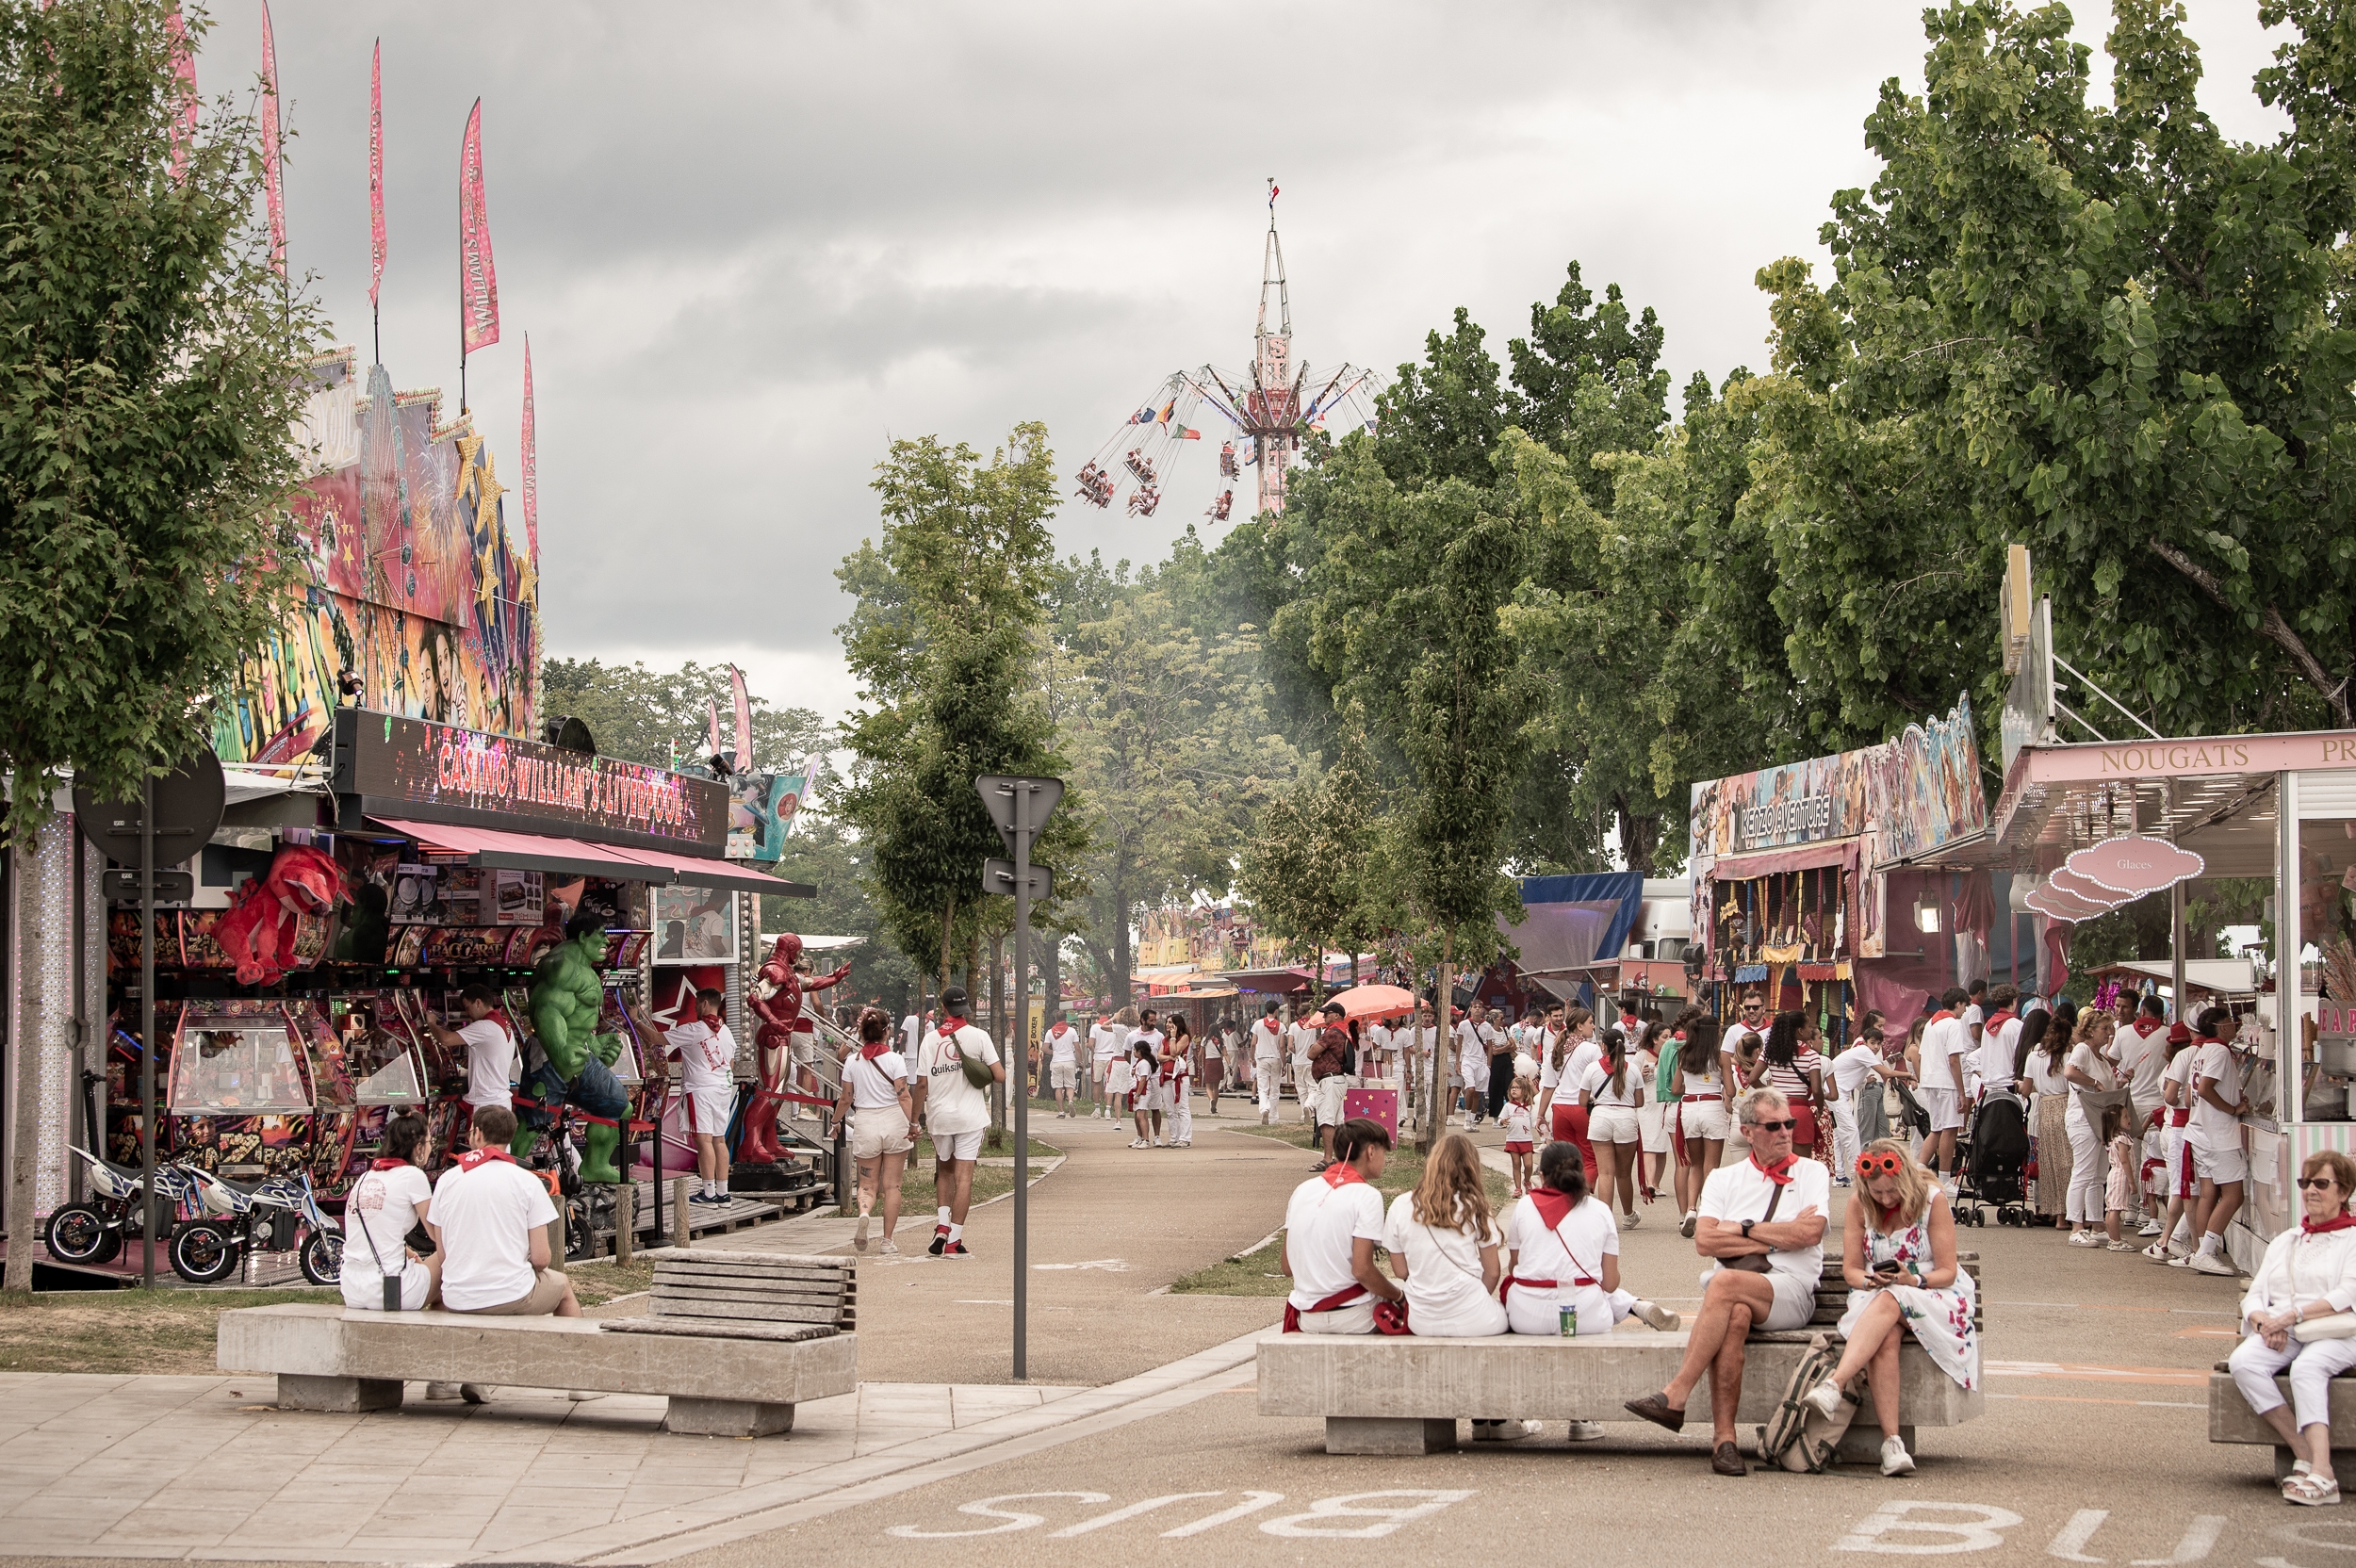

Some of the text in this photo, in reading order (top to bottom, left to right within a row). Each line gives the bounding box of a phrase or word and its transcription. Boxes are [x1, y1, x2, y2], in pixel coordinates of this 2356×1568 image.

[466, 238, 498, 334] WILLIAM'S
[2101, 739, 2356, 773] NOUGATS PR
[438, 743, 683, 826] CASINO WILLIAM'S LIVERPOOL
[1741, 794, 1831, 840] KENZO AVENTURE
[2117, 858, 2152, 871] Glaces
[431, 939, 503, 959] BACCARAT
[2331, 1008, 2342, 1033] A
[889, 1489, 1480, 1539] BUS
[1832, 1498, 2356, 1568] BUS
